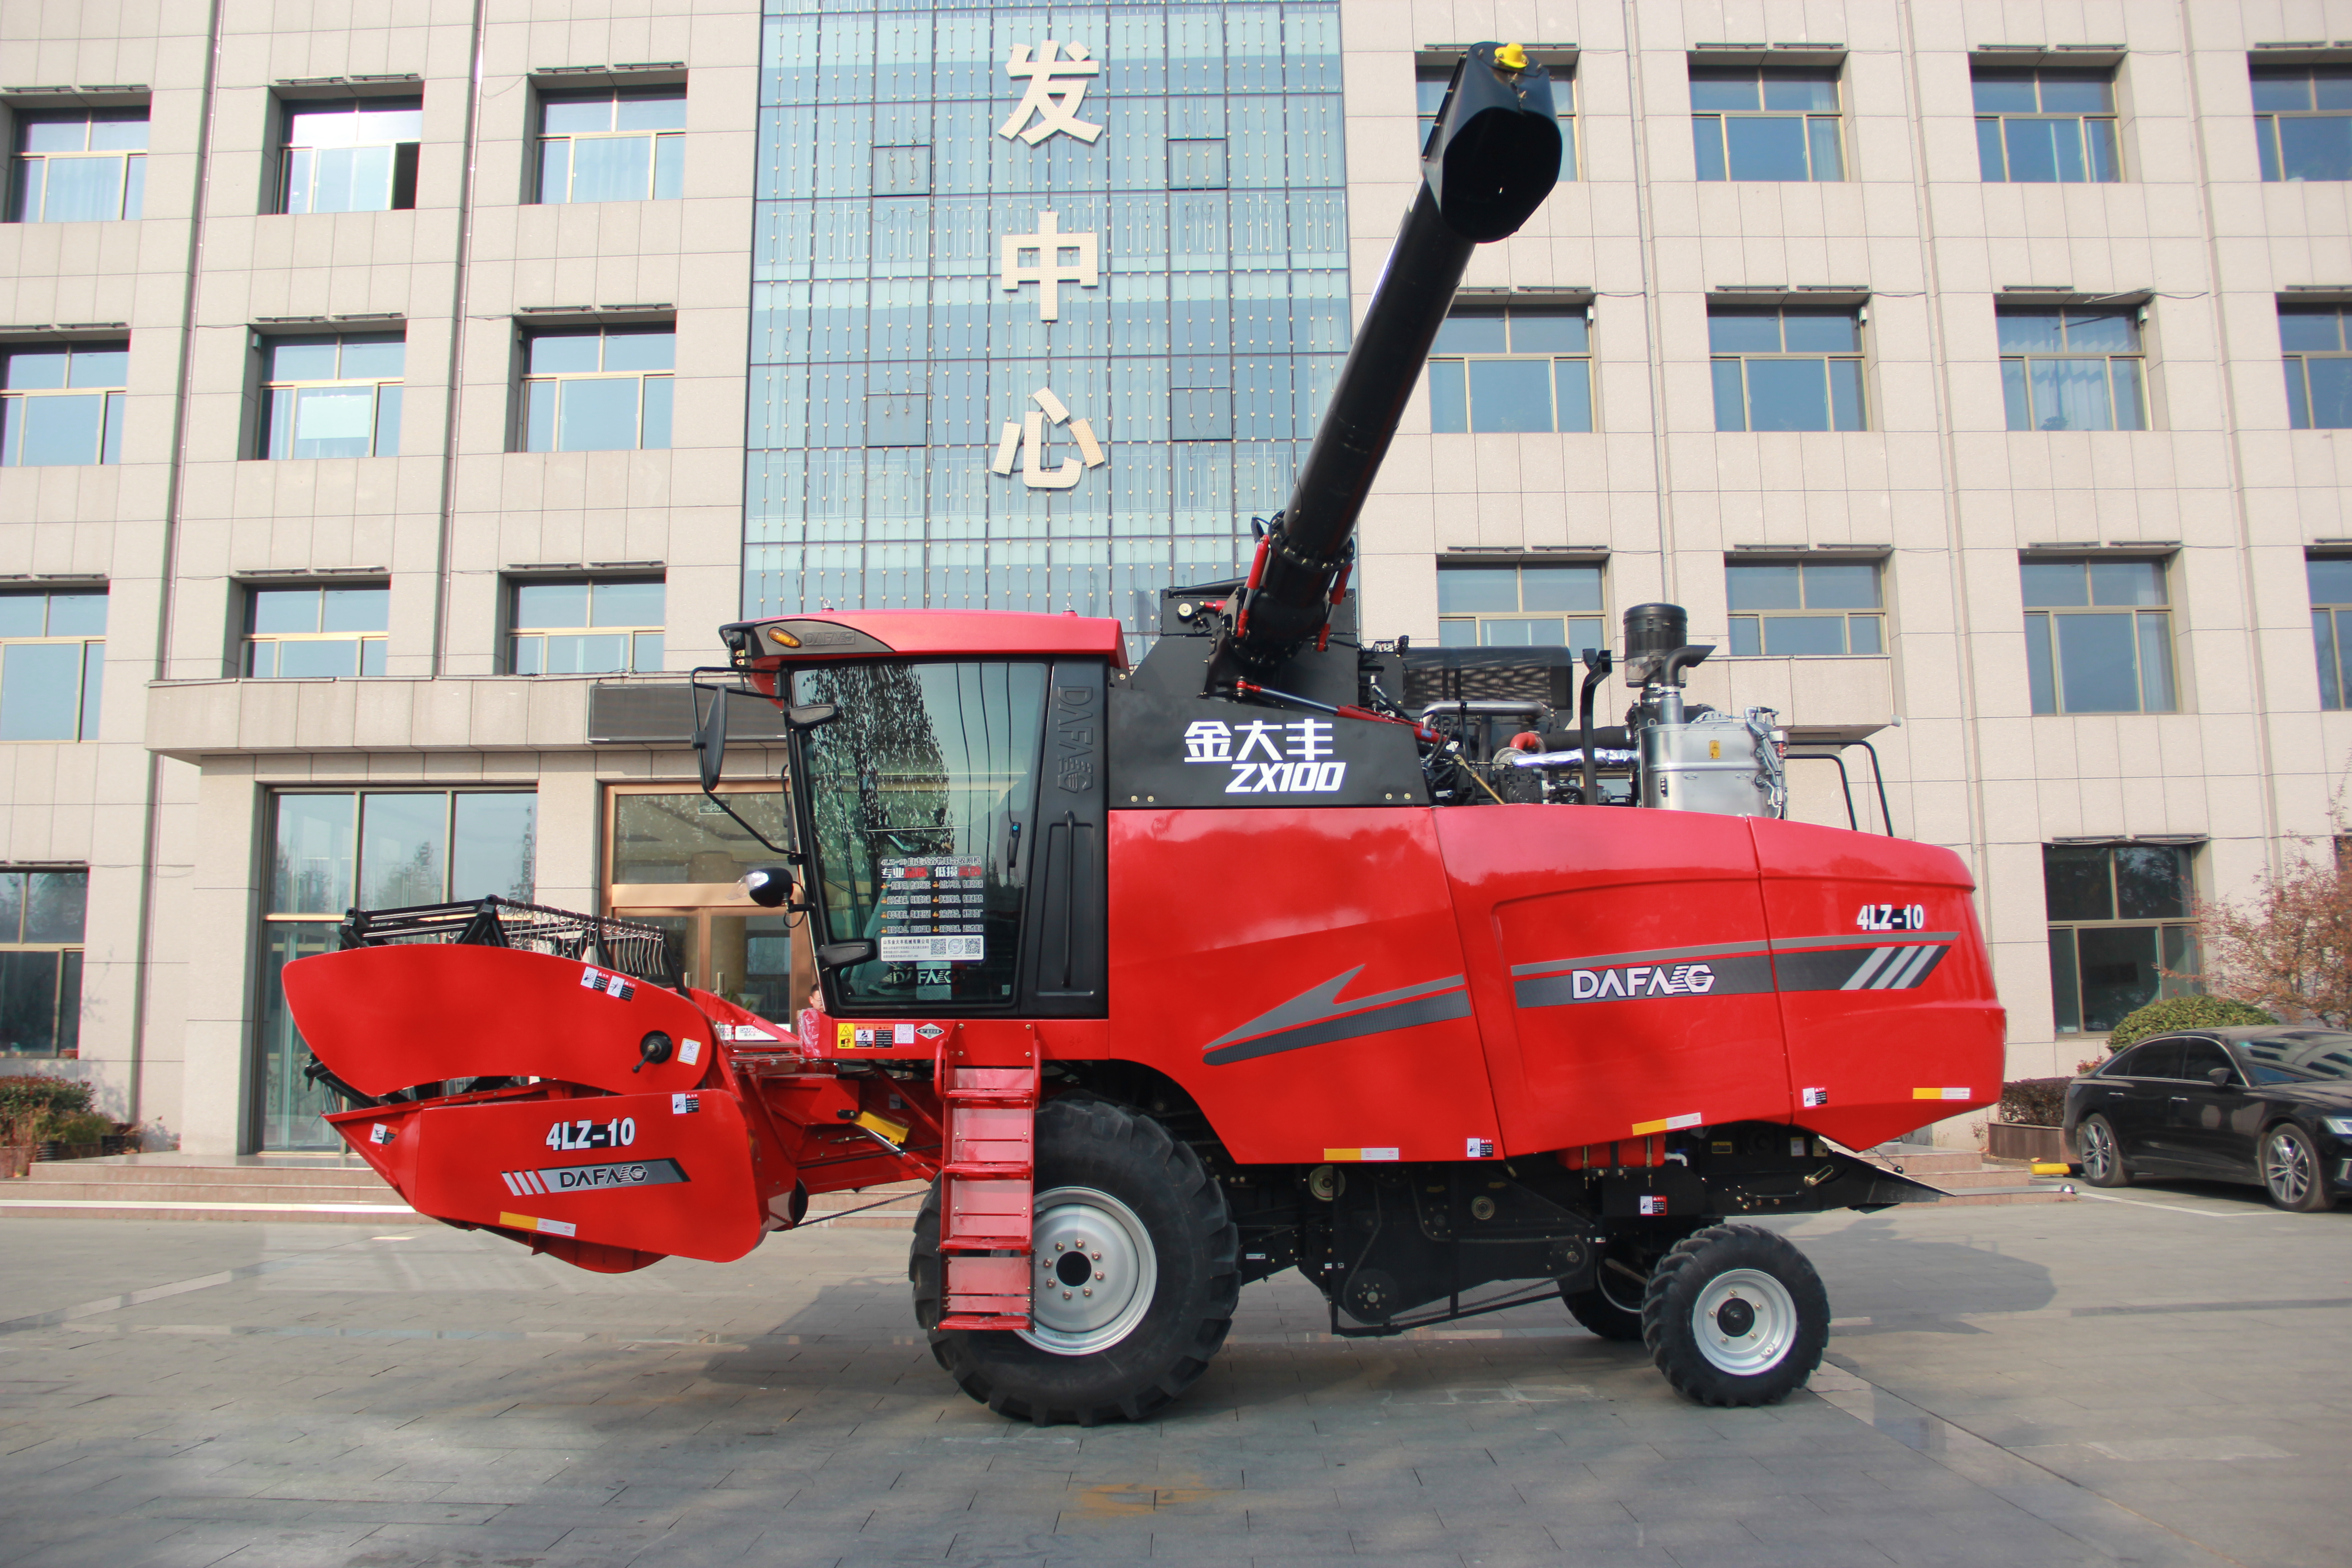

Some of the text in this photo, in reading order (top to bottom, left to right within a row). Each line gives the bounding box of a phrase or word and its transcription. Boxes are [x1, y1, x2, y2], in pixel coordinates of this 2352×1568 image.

[1184, 718, 1333, 763] 金大丰
[1225, 762, 1347, 793] ZX100
[881, 866, 982, 878] 专业品质 低损高效
[1856, 904, 1924, 931] 4LZ-10
[545, 1117, 636, 1152] 4LZ-10
